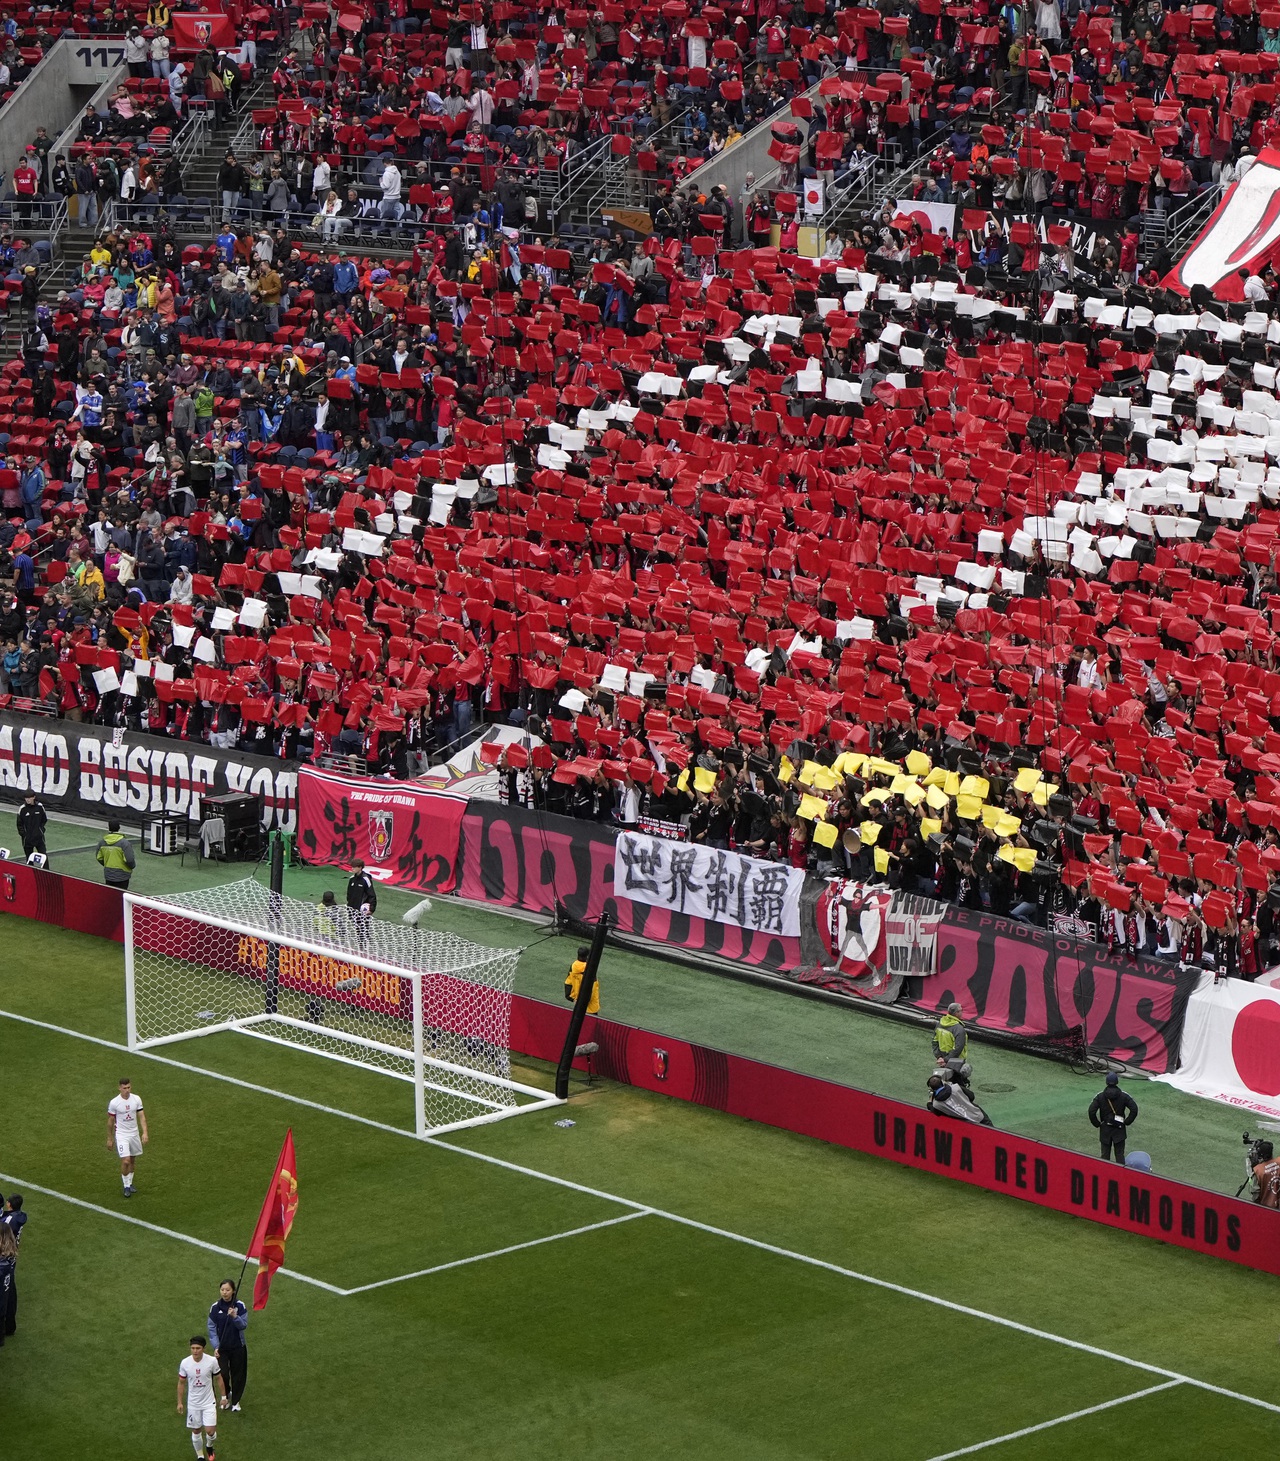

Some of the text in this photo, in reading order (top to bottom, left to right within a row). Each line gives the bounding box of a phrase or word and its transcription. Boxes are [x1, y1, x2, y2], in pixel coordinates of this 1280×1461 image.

[76, 47, 125, 67] 117
[77, 738, 217, 820] BESIDE
[225, 762, 297, 834] YOU
[350, 791, 363, 800] THE
[363, 793, 383, 803] PRIDE
[393, 795, 416, 807] URAWA
[619, 837, 790, 933] 世界制覇
[890, 889, 948, 915] PRIDE
[904, 918, 926, 944] OF
[944, 909, 970, 924] HE
[979, 917, 1045, 944] PRIDE
[1056, 939, 1087, 955] OF
[1094, 950, 1176, 980] URAWA
[873, 1112, 1241, 1252] URAWA RED DIAMONDS
